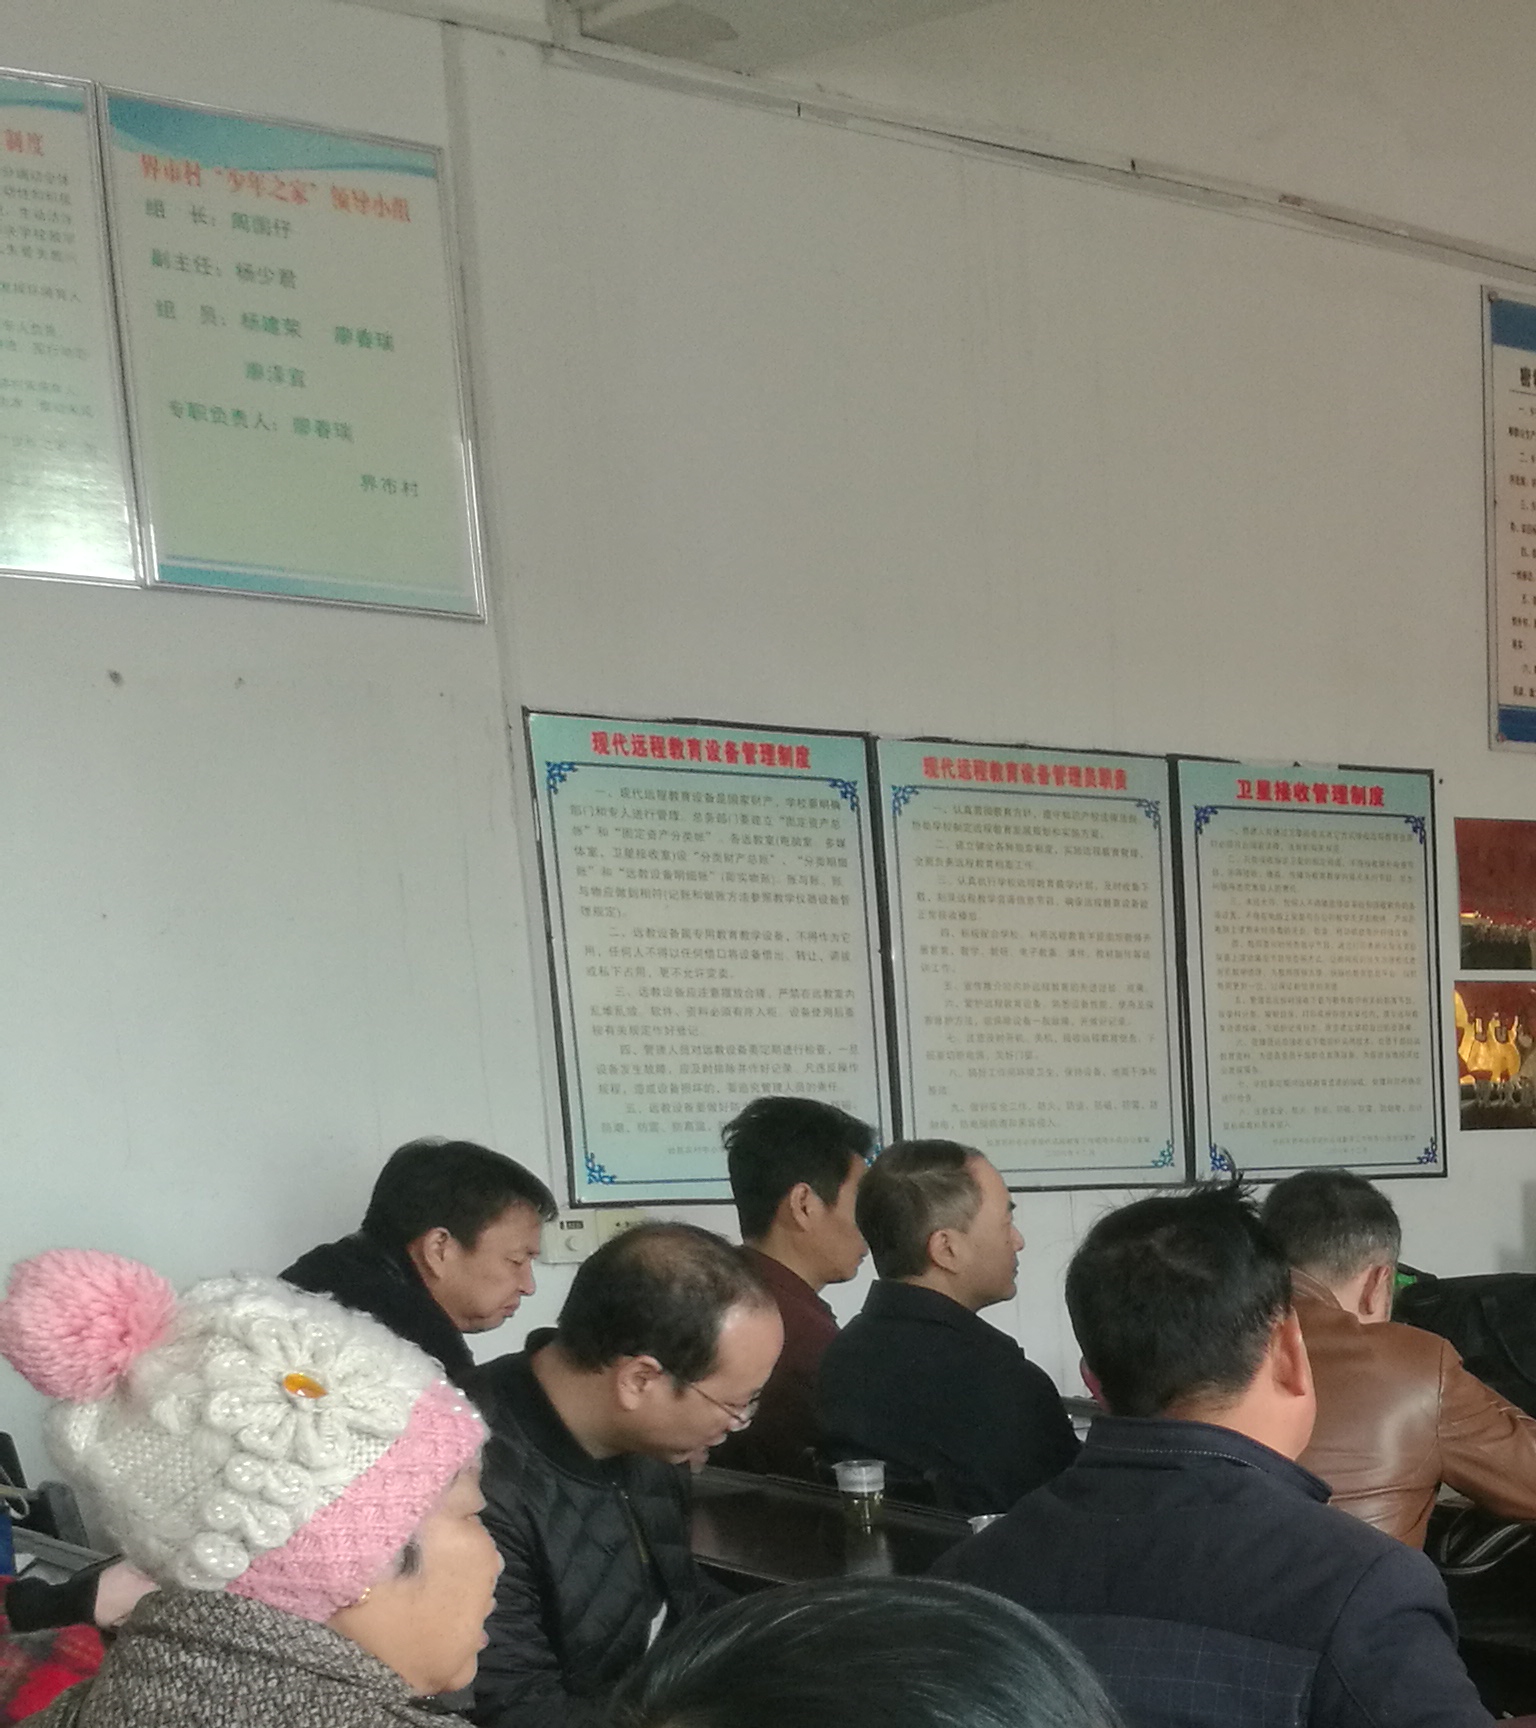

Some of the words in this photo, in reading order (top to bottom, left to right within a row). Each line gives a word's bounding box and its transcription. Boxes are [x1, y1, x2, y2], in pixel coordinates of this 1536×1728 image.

[591, 731, 811, 769] 现代远程教育设备管理制度
[922, 756, 1128, 791] 现代远程教育设备管理员职责
[1236, 779, 1384, 807] 卫星接收管理制度
